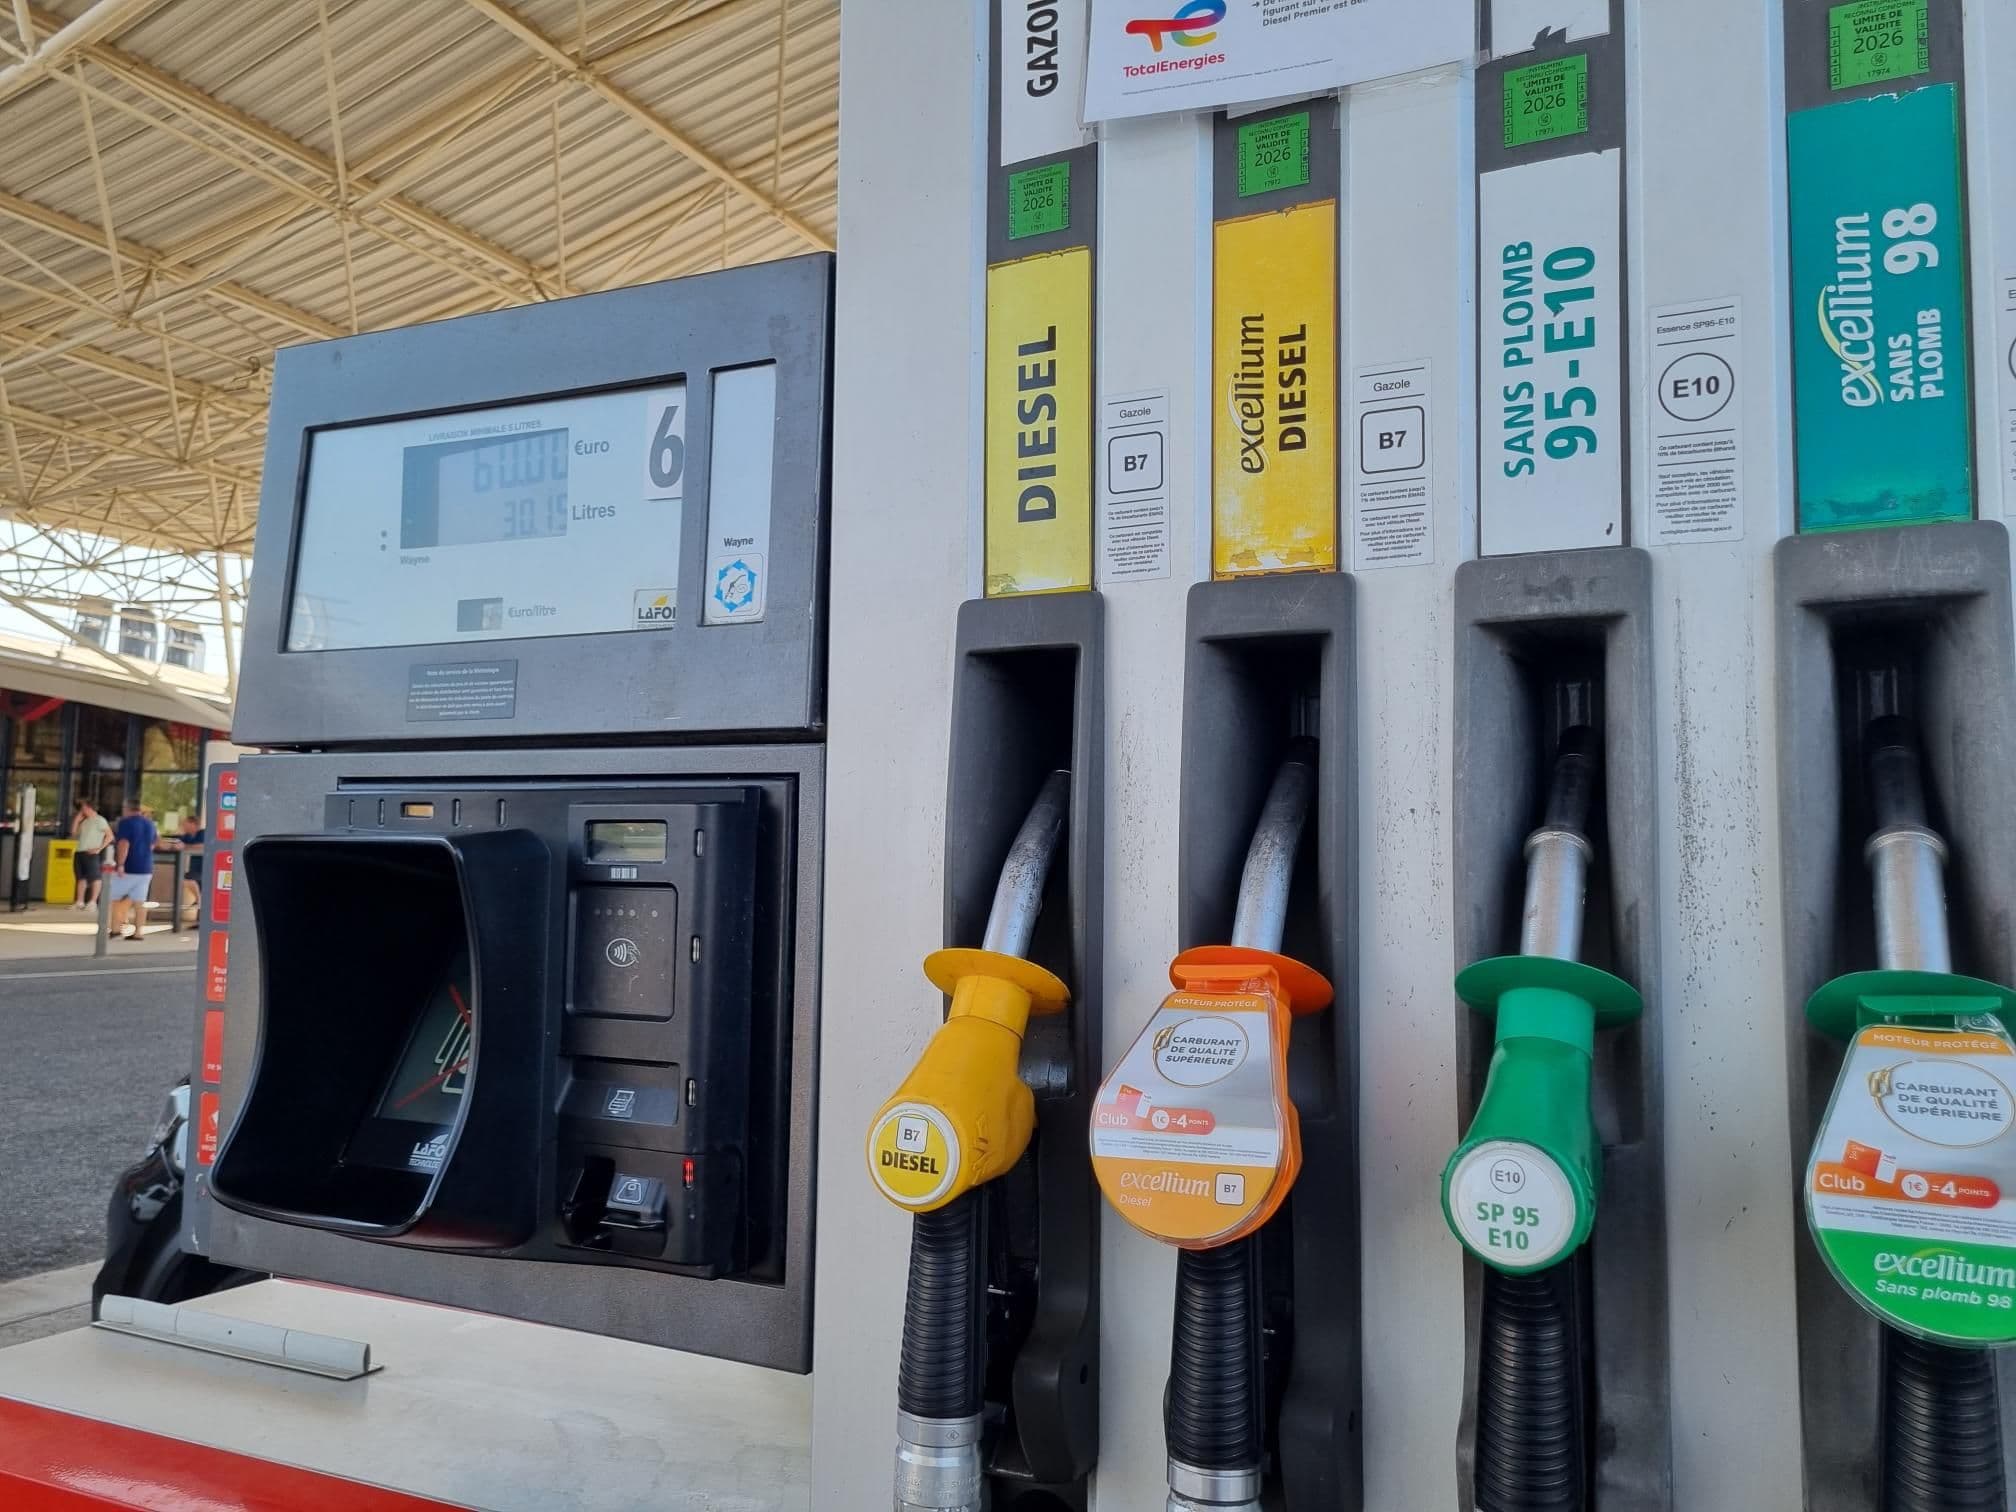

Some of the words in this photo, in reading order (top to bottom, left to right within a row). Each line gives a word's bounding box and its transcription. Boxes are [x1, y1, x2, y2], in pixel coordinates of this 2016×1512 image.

[1262, 2, 1300, 17] figurant
[1262, 14, 1291, 27] Diesel
[1294, 6, 1331, 20] Premier
[1333, 0, 1348, 9] est
[1853, 12, 1887, 26] LIMITE
[1889, 9, 1903, 19] DE
[1854, 19, 1902, 35] VALIDITE
[1853, 30, 1904, 55] 2026
[1122, 53, 1226, 78] TotalEnergies
[1523, 77, 1551, 89] LIMITE
[1524, 83, 1564, 97] VALIDITE
[1523, 93, 1566, 115] 2026
[1255, 132, 1278, 143] LIMITE
[1280, 129, 1291, 137] DE
[1256, 139, 1289, 150] VALIDITE
[1255, 147, 1291, 167] 2026
[1023, 180, 1044, 190] LIMITE
[1044, 177, 1054, 185] DE
[1024, 186, 1053, 197] VALIDITE
[1022, 194, 1055, 212] 2026
[1882, 202, 1940, 275] 98
[1503, 240, 1534, 369] PLOMB
[1826, 211, 1877, 408] excellium
[1656, 323, 1692, 335] Essence
[1693, 316, 1736, 330] SP95-E10
[1542, 246, 1598, 460] 95-E10
[1916, 308, 1945, 400] PLOMB
[1888, 333, 1915, 402] SANS
[1233, 312, 1265, 474] excellium
[1278, 323, 1307, 452] DIESEL
[1373, 379, 1411, 393] Gazole
[1672, 375, 1720, 399] E10
[1119, 406, 1152, 419] Gazole
[1017, 325, 1057, 523] DIESEL
[1503, 381, 1535, 478] SANS
[574, 438, 611, 456] €uro
[648, 405, 686, 489] 6
[1378, 430, 1408, 450] B7
[1123, 453, 1149, 473] B7
[572, 504, 617, 521] Litres
[724, 536, 754, 549] Wayne
[1174, 998, 1213, 1008] MOTEUR
[1172, 1036, 1242, 1048] CARBURANT
[1873, 1033, 1931, 1048] MOTEUR
[1170, 1045, 1186, 1054] DE
[1188, 1045, 1238, 1056] QUALITÉ
[1165, 1055, 1236, 1066] SUPÉRIEURE
[1895, 1081, 1999, 1098] CARBURANT
[1898, 1093, 1921, 1104] DE
[1925, 1095, 1999, 1110] QUALITÉ
[1099, 1111, 1129, 1126] Club
[1896, 1104, 2003, 1122] SUPÉRIEURE
[1188, 1118, 1209, 1127] POINTS
[903, 1128, 921, 1142] B7
[881, 1149, 939, 1175] DIESEL
[1120, 1170, 1211, 1198] excellium
[1494, 1169, 1521, 1184] E10
[1819, 1172, 1866, 1192] Club
[1223, 1184, 1237, 1193] B7
[1907, 1179, 1923, 1192] 1€
[1958, 1188, 1991, 1198] POINTS
[1119, 1193, 1153, 1208] Diesel
[1476, 1201, 1505, 1223] SP
[1512, 1205, 1540, 1228] 95
[1487, 1227, 1530, 1251] E10
[1873, 1251, 2016, 1289] excellium
[1874, 1279, 1918, 1297] Sans
[1921, 1286, 1983, 1305] plomb
[1986, 1293, 2014, 1309] 98
